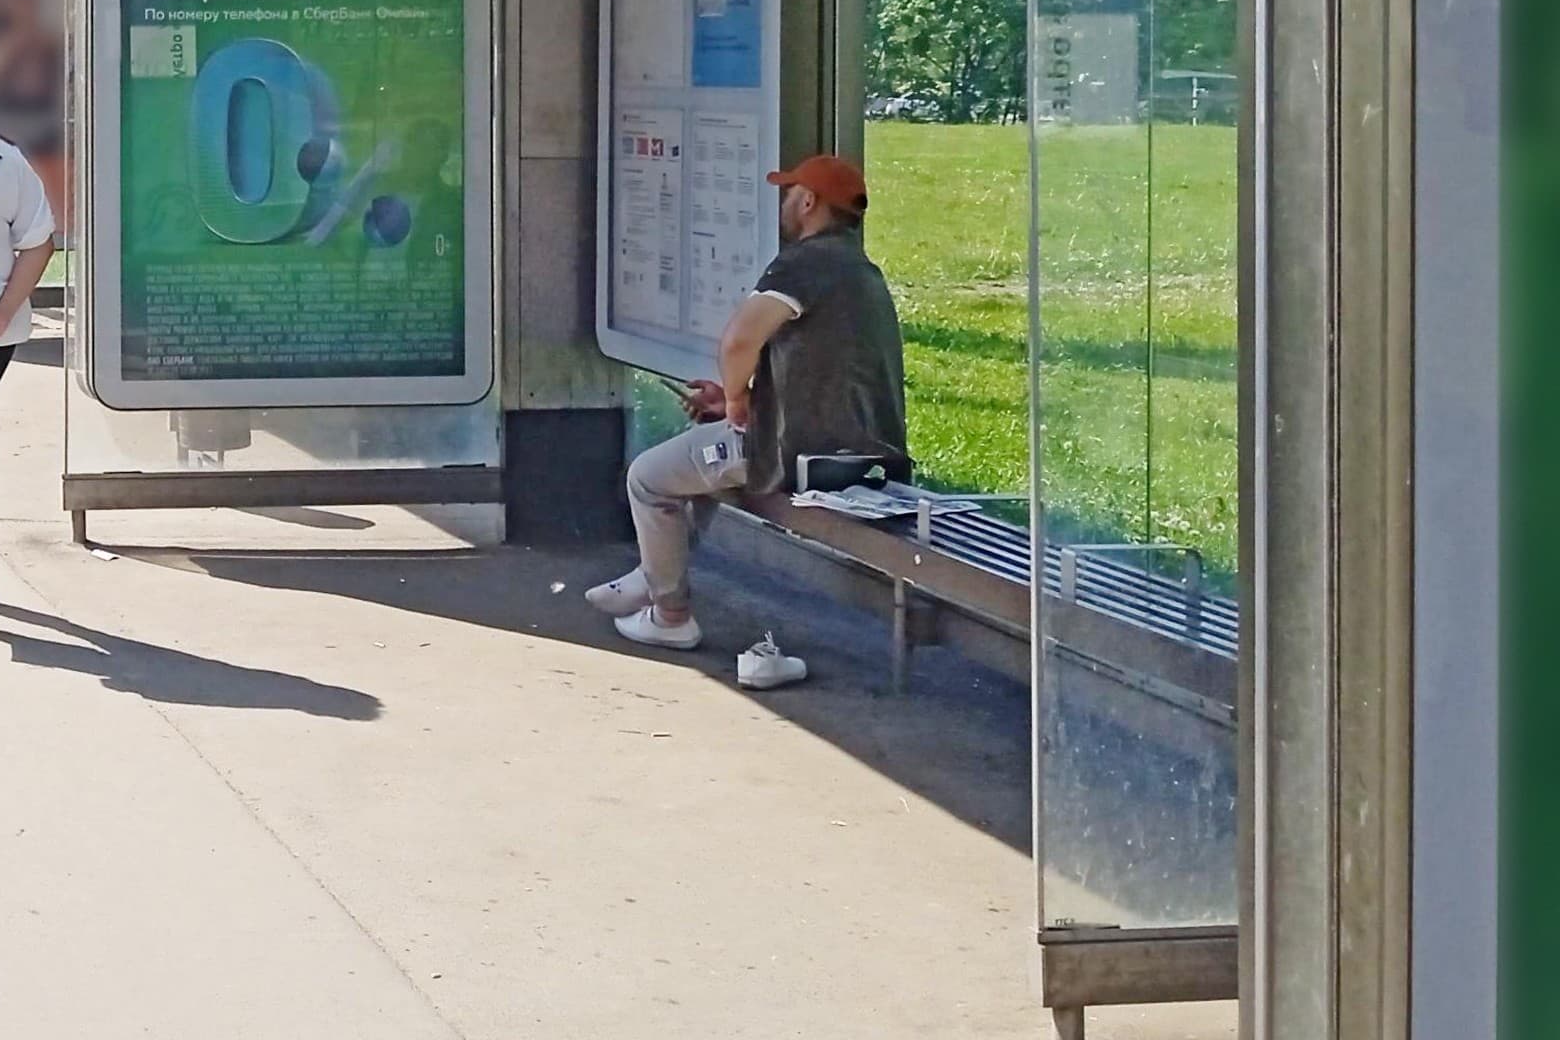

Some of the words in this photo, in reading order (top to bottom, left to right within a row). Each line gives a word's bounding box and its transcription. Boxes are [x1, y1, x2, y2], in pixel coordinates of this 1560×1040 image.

[145, 8, 165, 21] По
[168, 10, 219, 24] номеру
[222, 8, 289, 24] телефона
